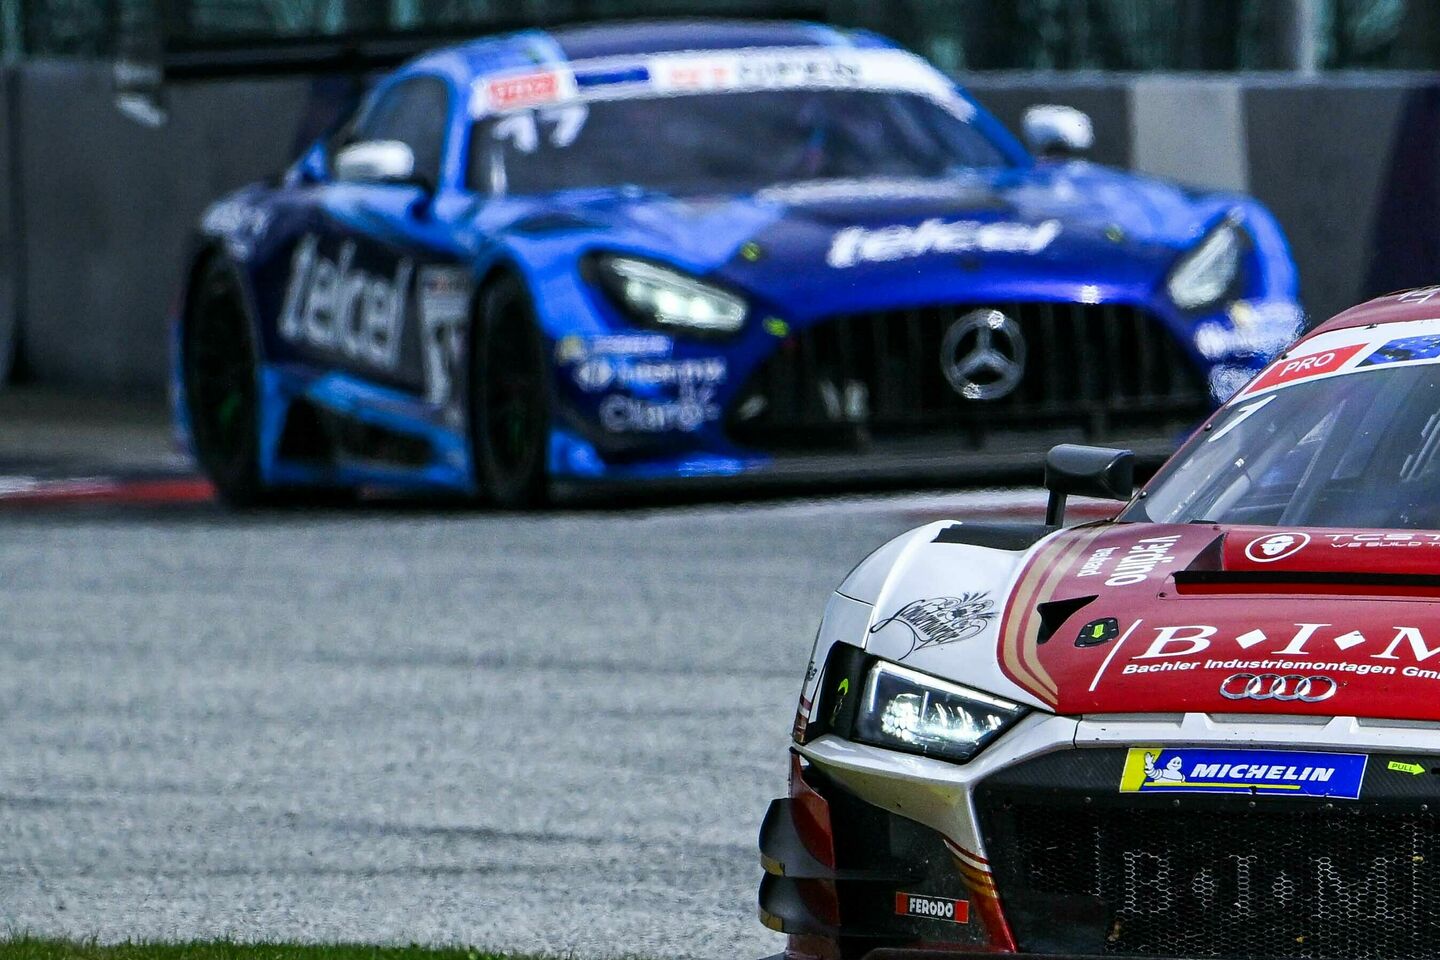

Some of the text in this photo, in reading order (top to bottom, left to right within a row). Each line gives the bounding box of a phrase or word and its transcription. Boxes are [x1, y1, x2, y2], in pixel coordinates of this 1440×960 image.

[278, 234, 414, 372] telcel
[1279, 352, 1336, 377] PRO
[1325, 532, 1413, 542] TCS
[1122, 660, 1202, 676] Bachler
[1203, 657, 1396, 677] Industriemontagen
[1189, 762, 1336, 784] MICHELIN
[1390, 762, 1416, 774] PULL
[908, 898, 955, 918] FERODO
